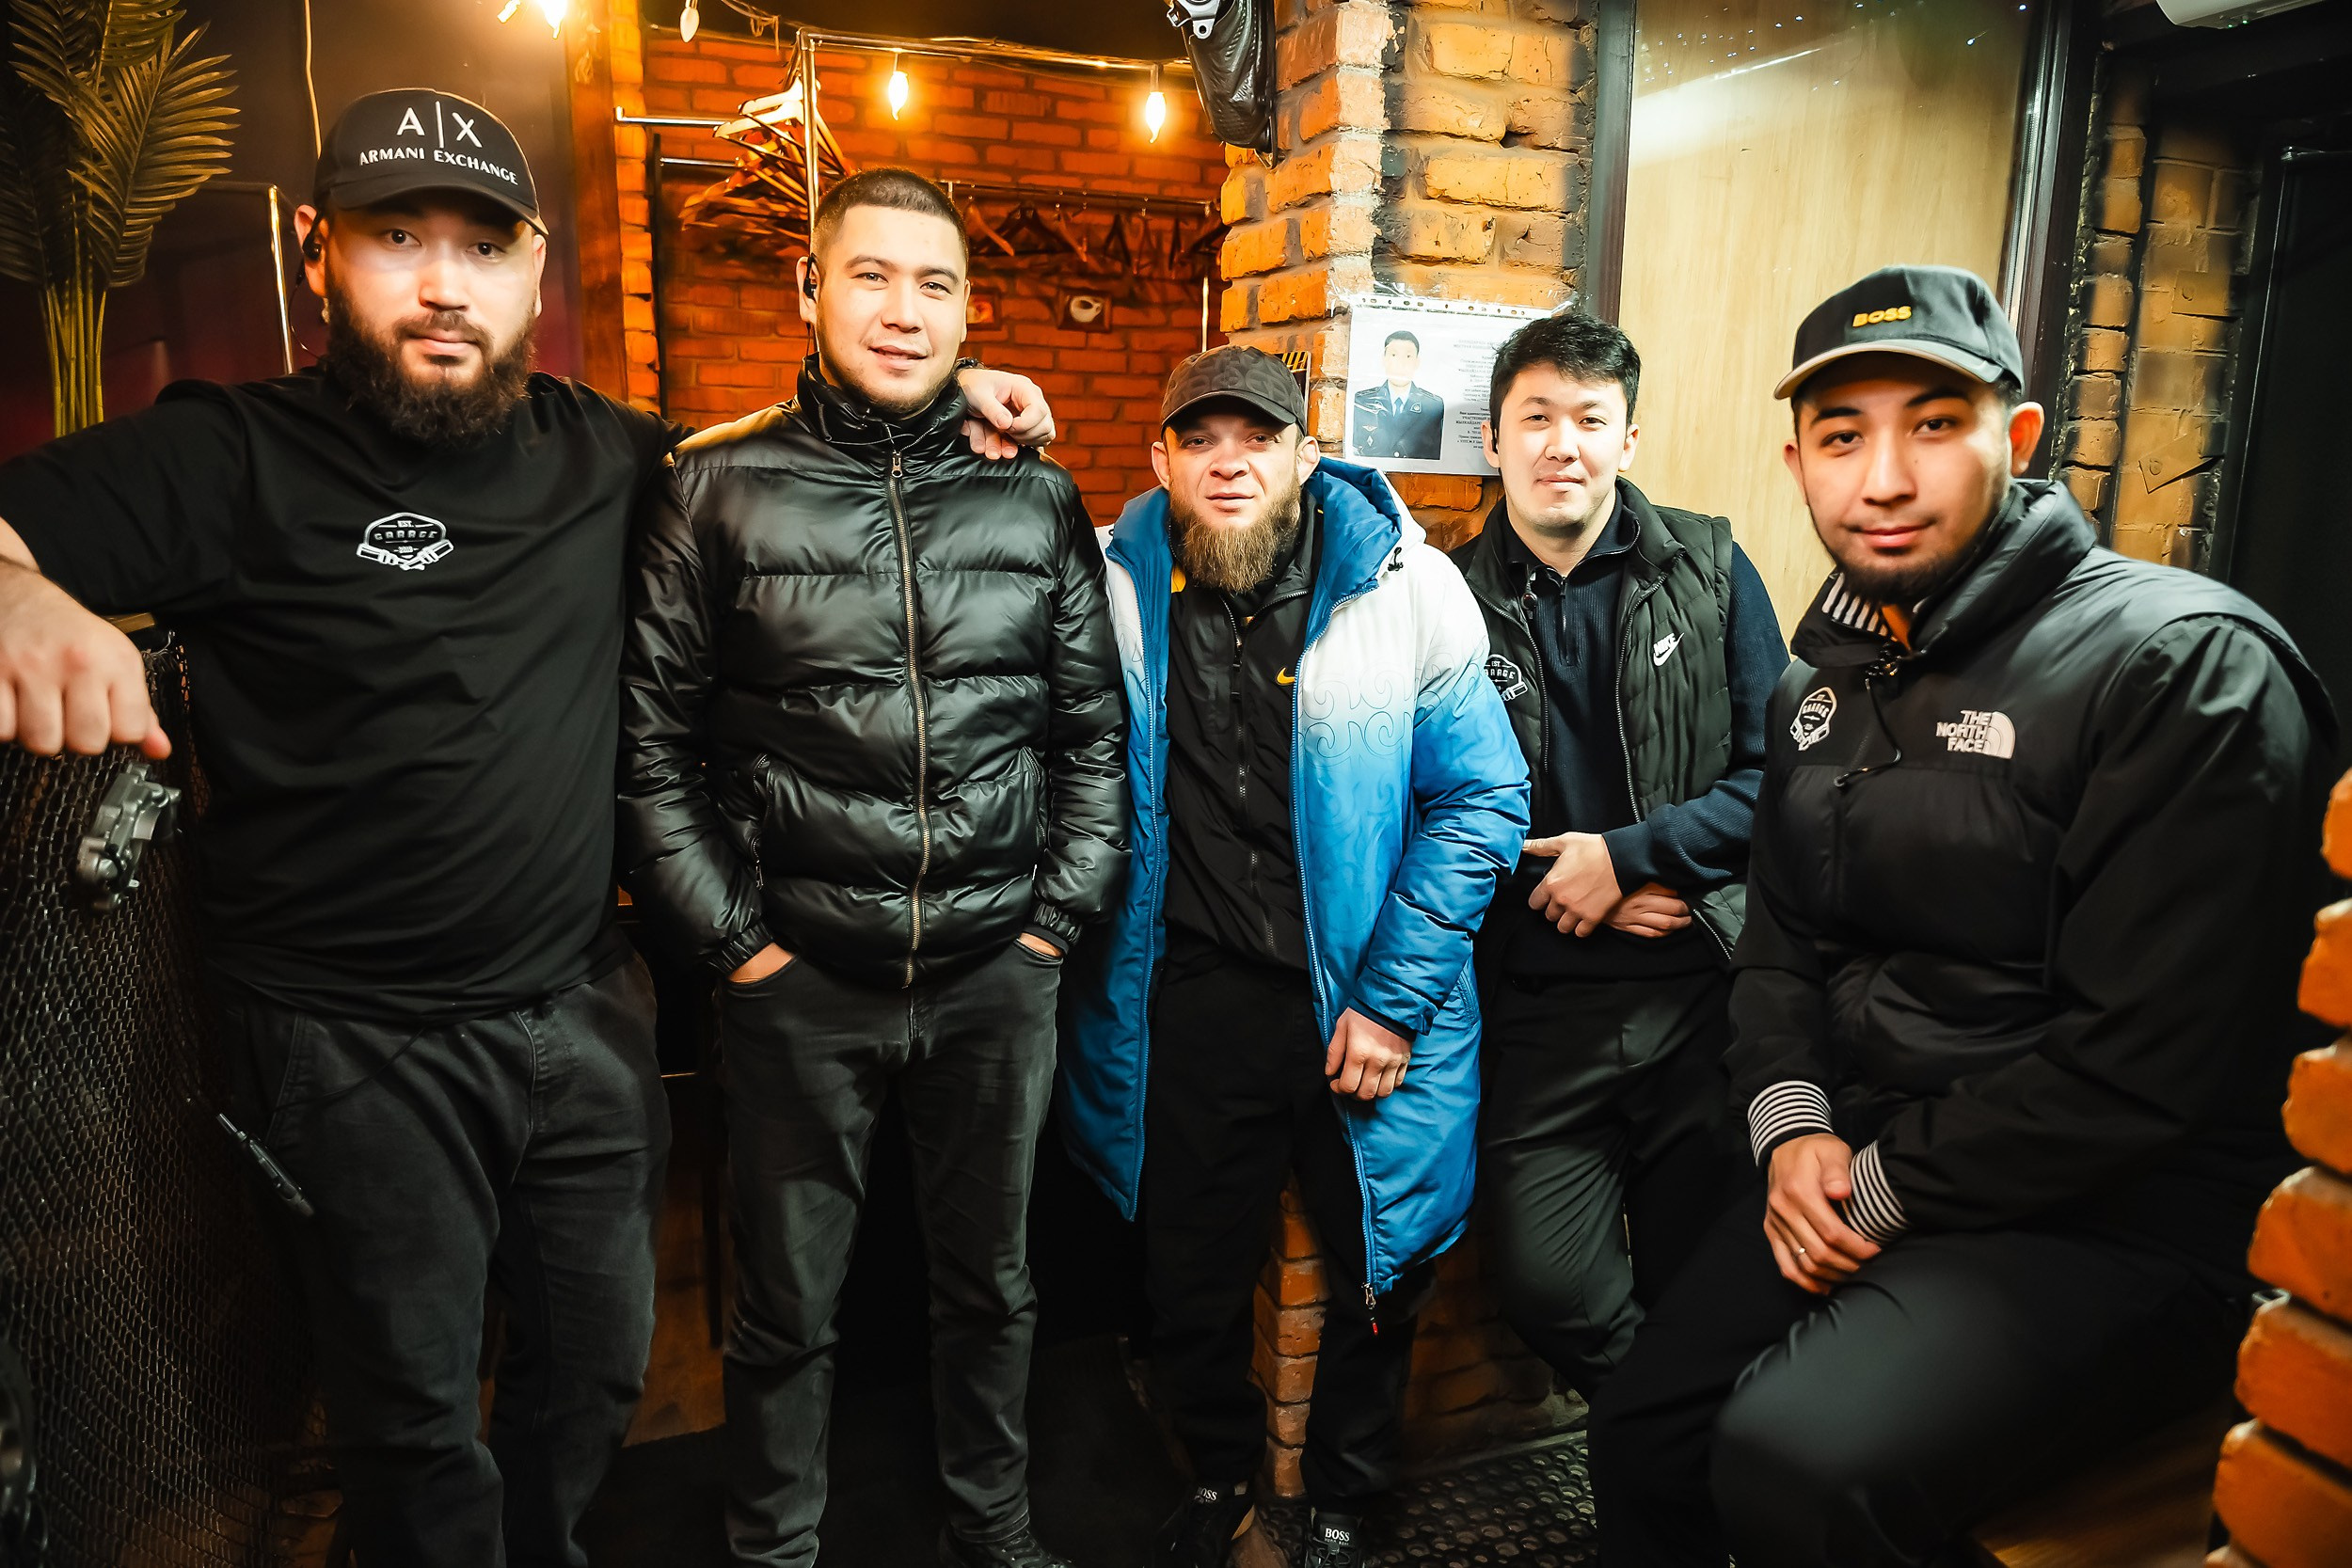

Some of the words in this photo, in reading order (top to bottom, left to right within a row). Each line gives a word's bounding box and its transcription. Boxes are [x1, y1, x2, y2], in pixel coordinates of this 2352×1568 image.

[358, 147, 425, 166] ARMANI
[433, 149, 518, 185] EXCHANGE
[1851, 305, 1912, 327] BOSS
[374, 531, 438, 541] GARAGE
[1653, 632, 1676, 657] NIKE
[1484, 668, 1516, 679] ARAGE
[1960, 709, 1993, 726] THE
[1935, 721, 1988, 740] NORTH
[1947, 736, 1985, 752] FACE
[1325, 1528, 1350, 1543] BOSS
